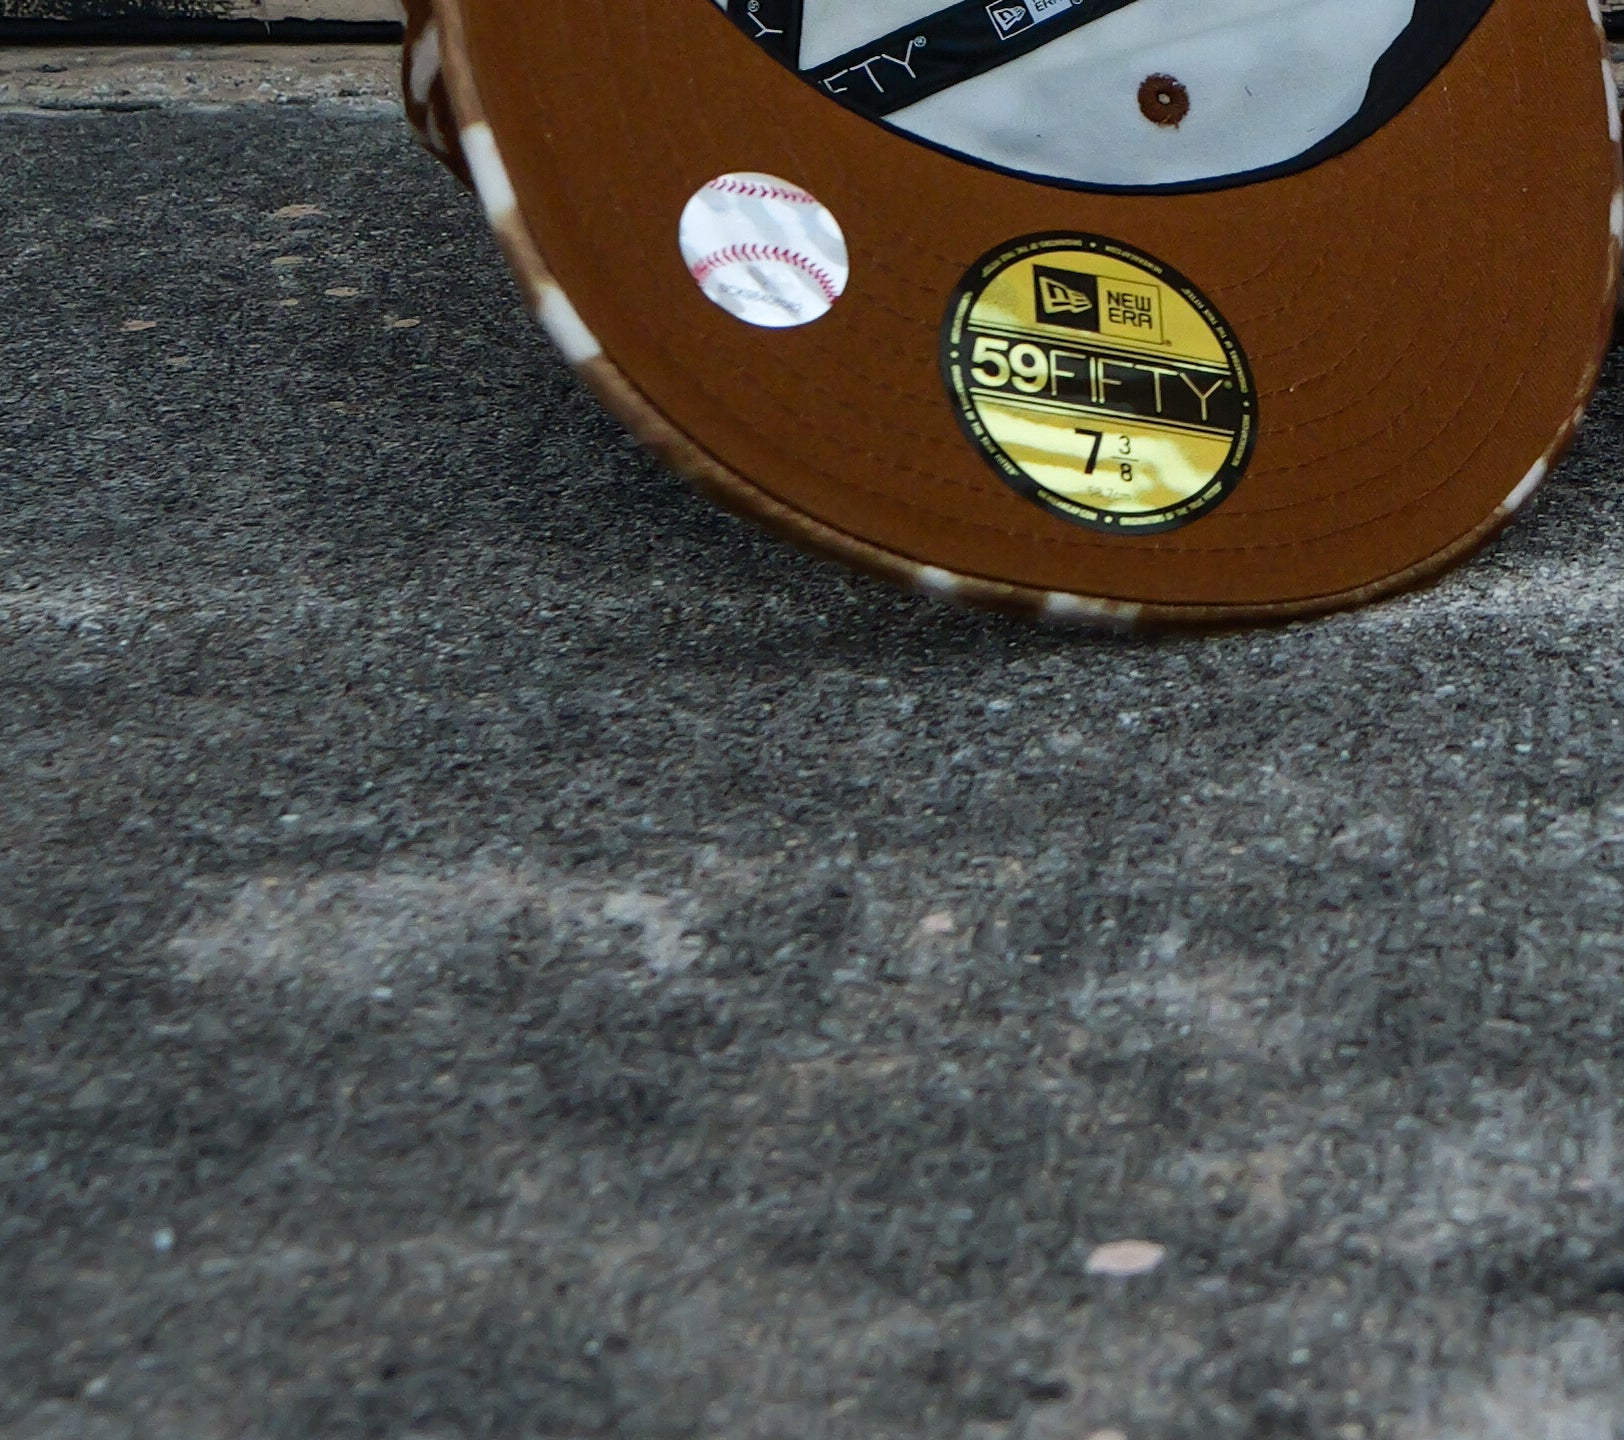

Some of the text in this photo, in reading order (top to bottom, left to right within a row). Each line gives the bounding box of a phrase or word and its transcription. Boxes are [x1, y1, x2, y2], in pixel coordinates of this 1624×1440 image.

[1106, 289, 1152, 312] NEW
[1108, 307, 1153, 330] ERA
[970, 336, 1224, 421] 59FIFTY
[1074, 427, 1104, 475] 7
